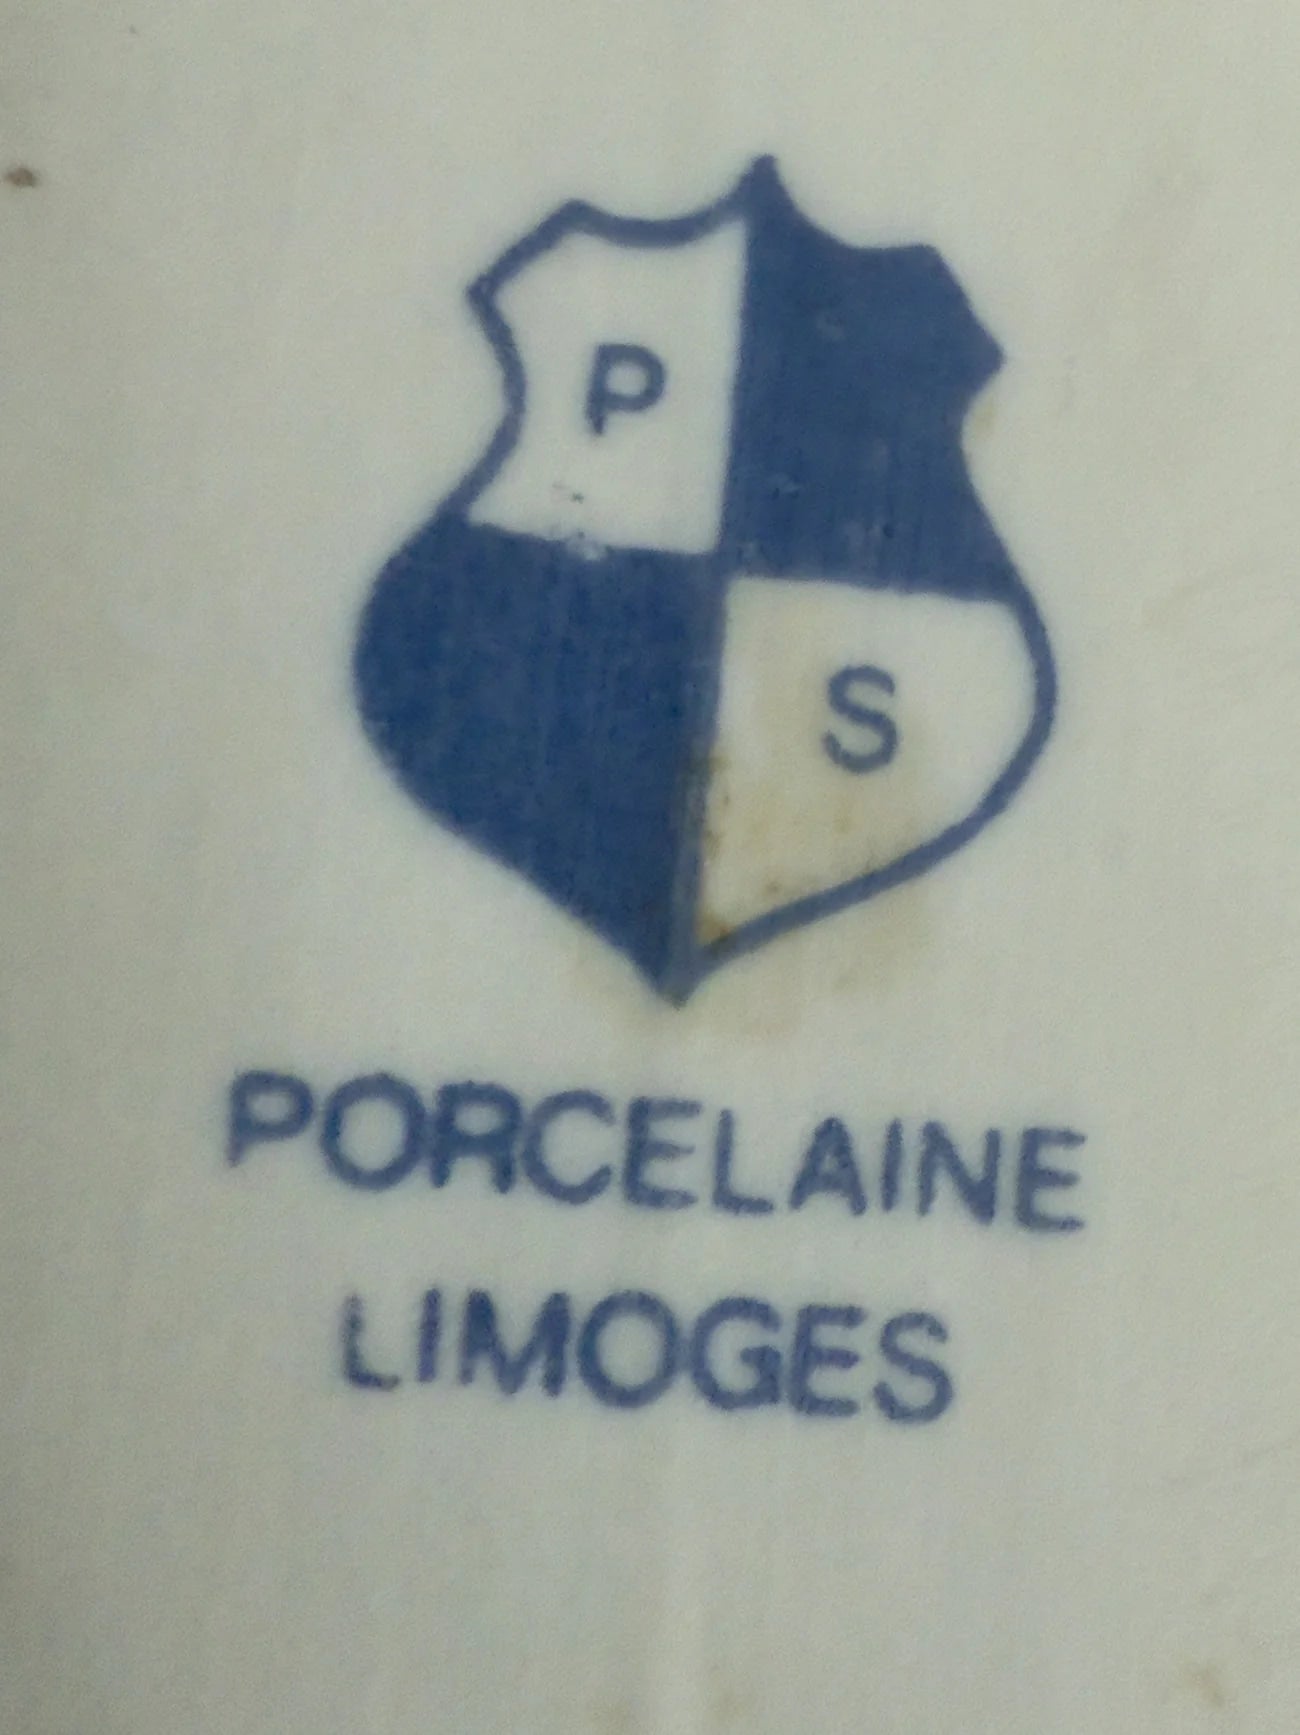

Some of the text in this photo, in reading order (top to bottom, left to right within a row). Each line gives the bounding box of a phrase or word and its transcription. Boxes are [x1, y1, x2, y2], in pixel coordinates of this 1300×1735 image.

[586, 343, 666, 434] P
[824, 665, 898, 773] S
[228, 1070, 1085, 1231] PORCELAINE
[342, 1289, 953, 1424] LIMOGES
